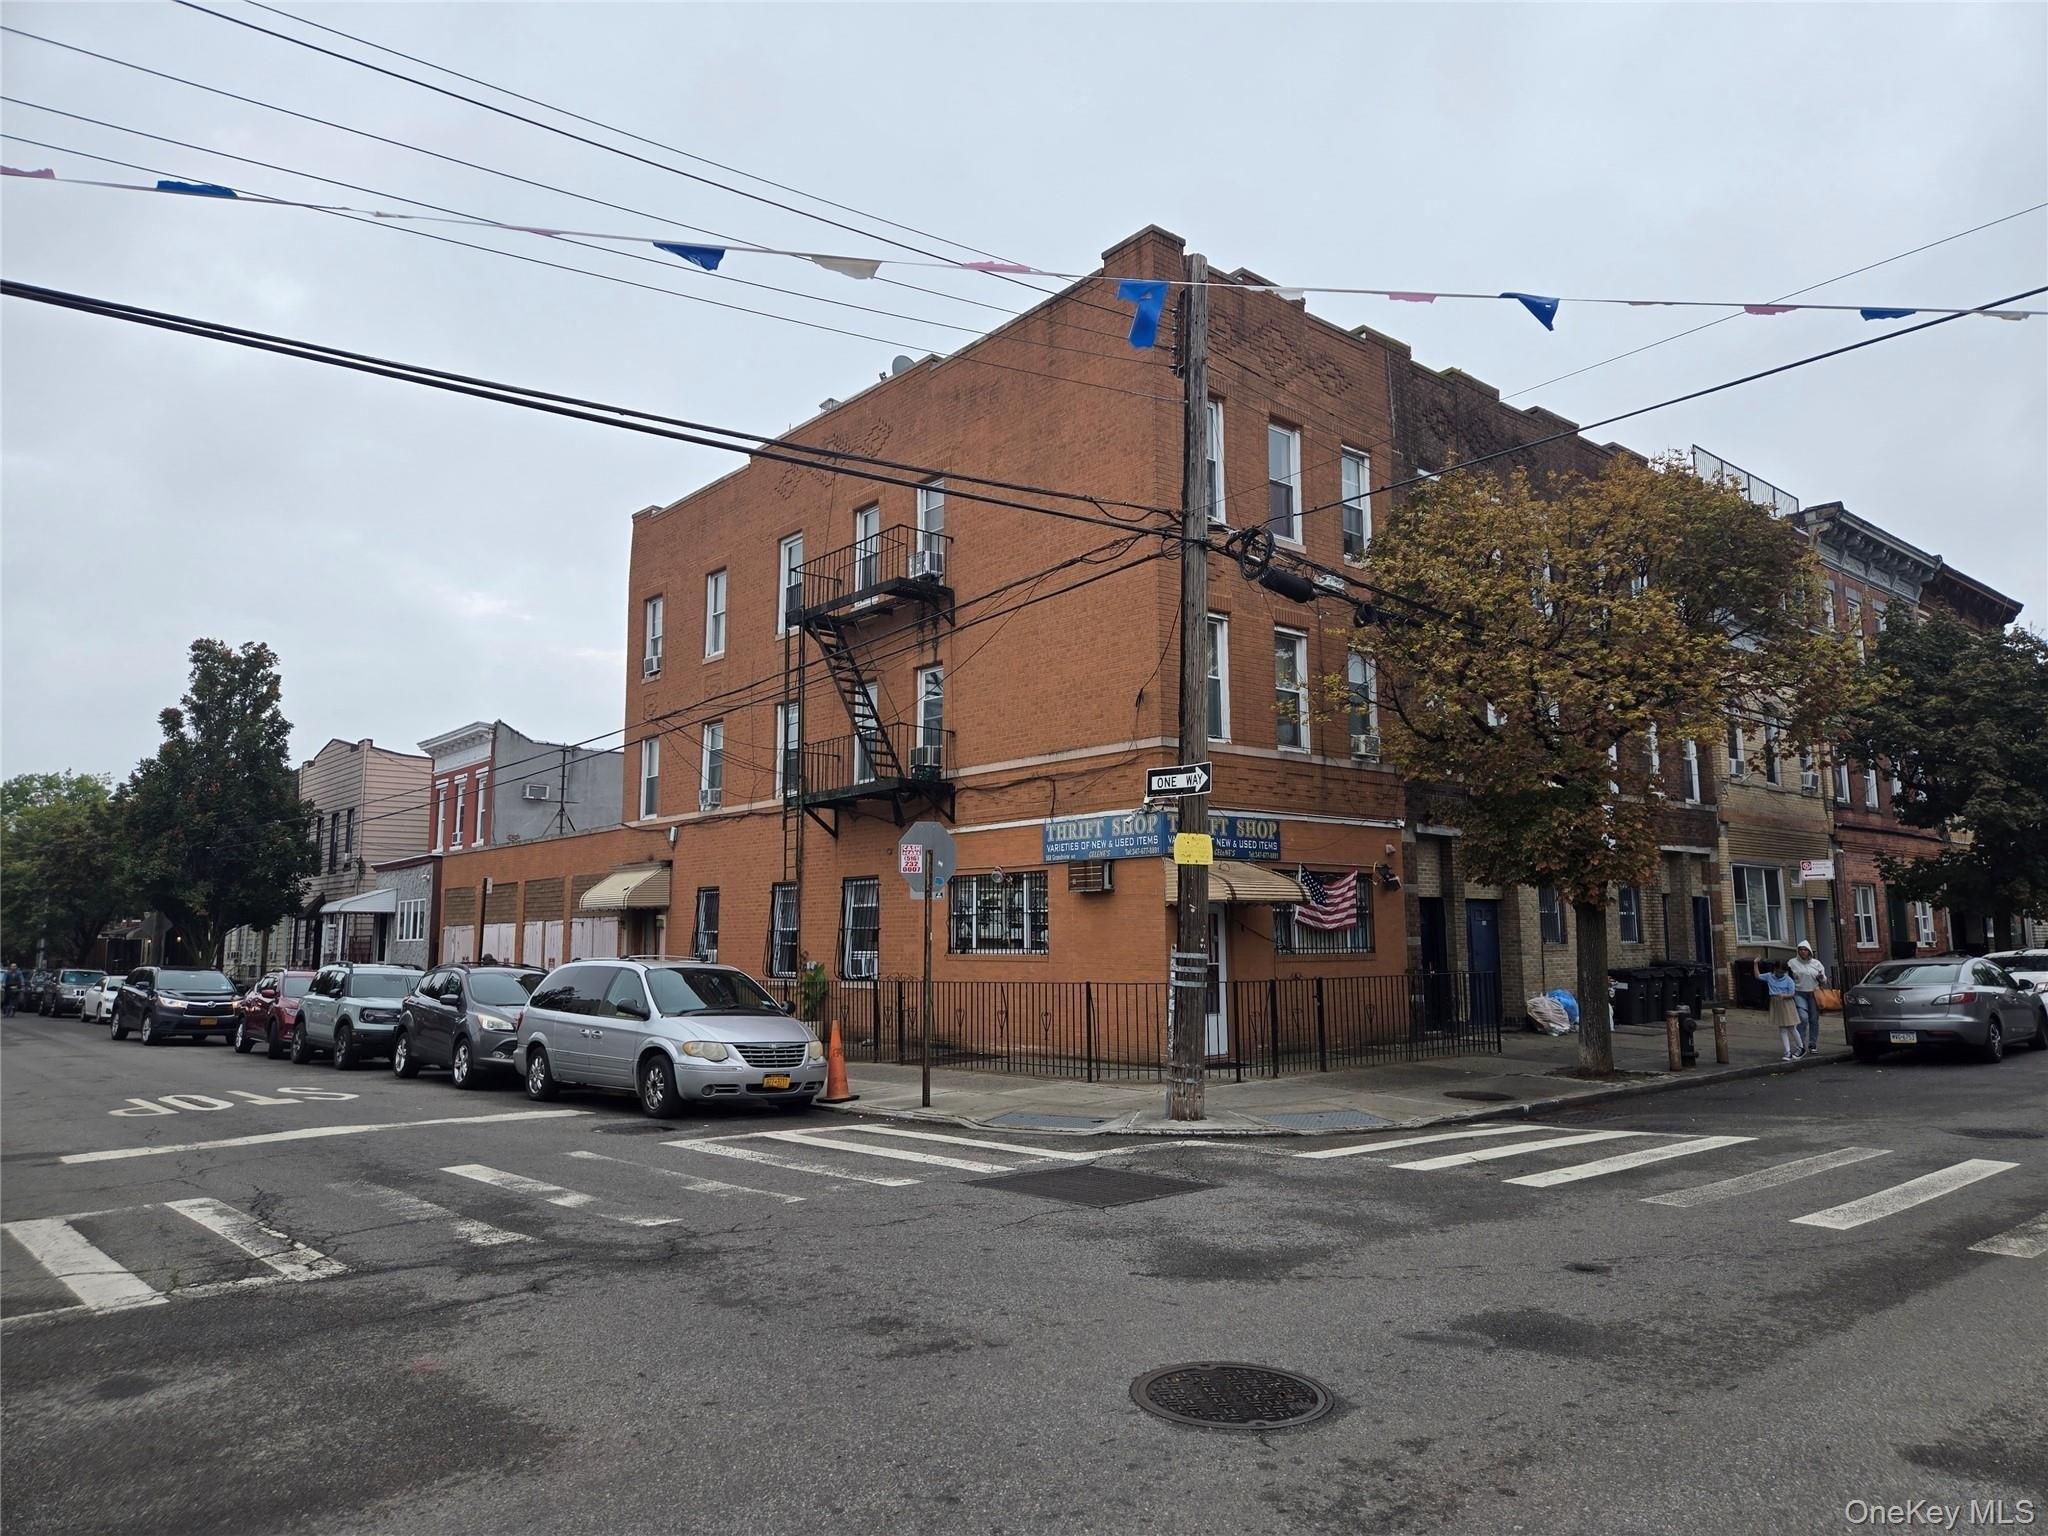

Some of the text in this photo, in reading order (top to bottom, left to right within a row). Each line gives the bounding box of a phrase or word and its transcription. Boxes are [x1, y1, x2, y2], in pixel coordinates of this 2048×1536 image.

[1157, 773, 1203, 789] ONE WAY
[1046, 815, 1157, 841] THRIFT SHOP
[1236, 820, 1277, 839] SHOP
[1047, 842, 1079, 852] VARIETIES
[1081, 841, 1090, 849] OF
[1091, 839, 1107, 849] NEW
[1115, 838, 1134, 847] USED
[1136, 835, 1158, 845] ITEMS
[1216, 837, 1278, 851] NEW & USED ITEMS
[108, 1087, 360, 1117] STOP
